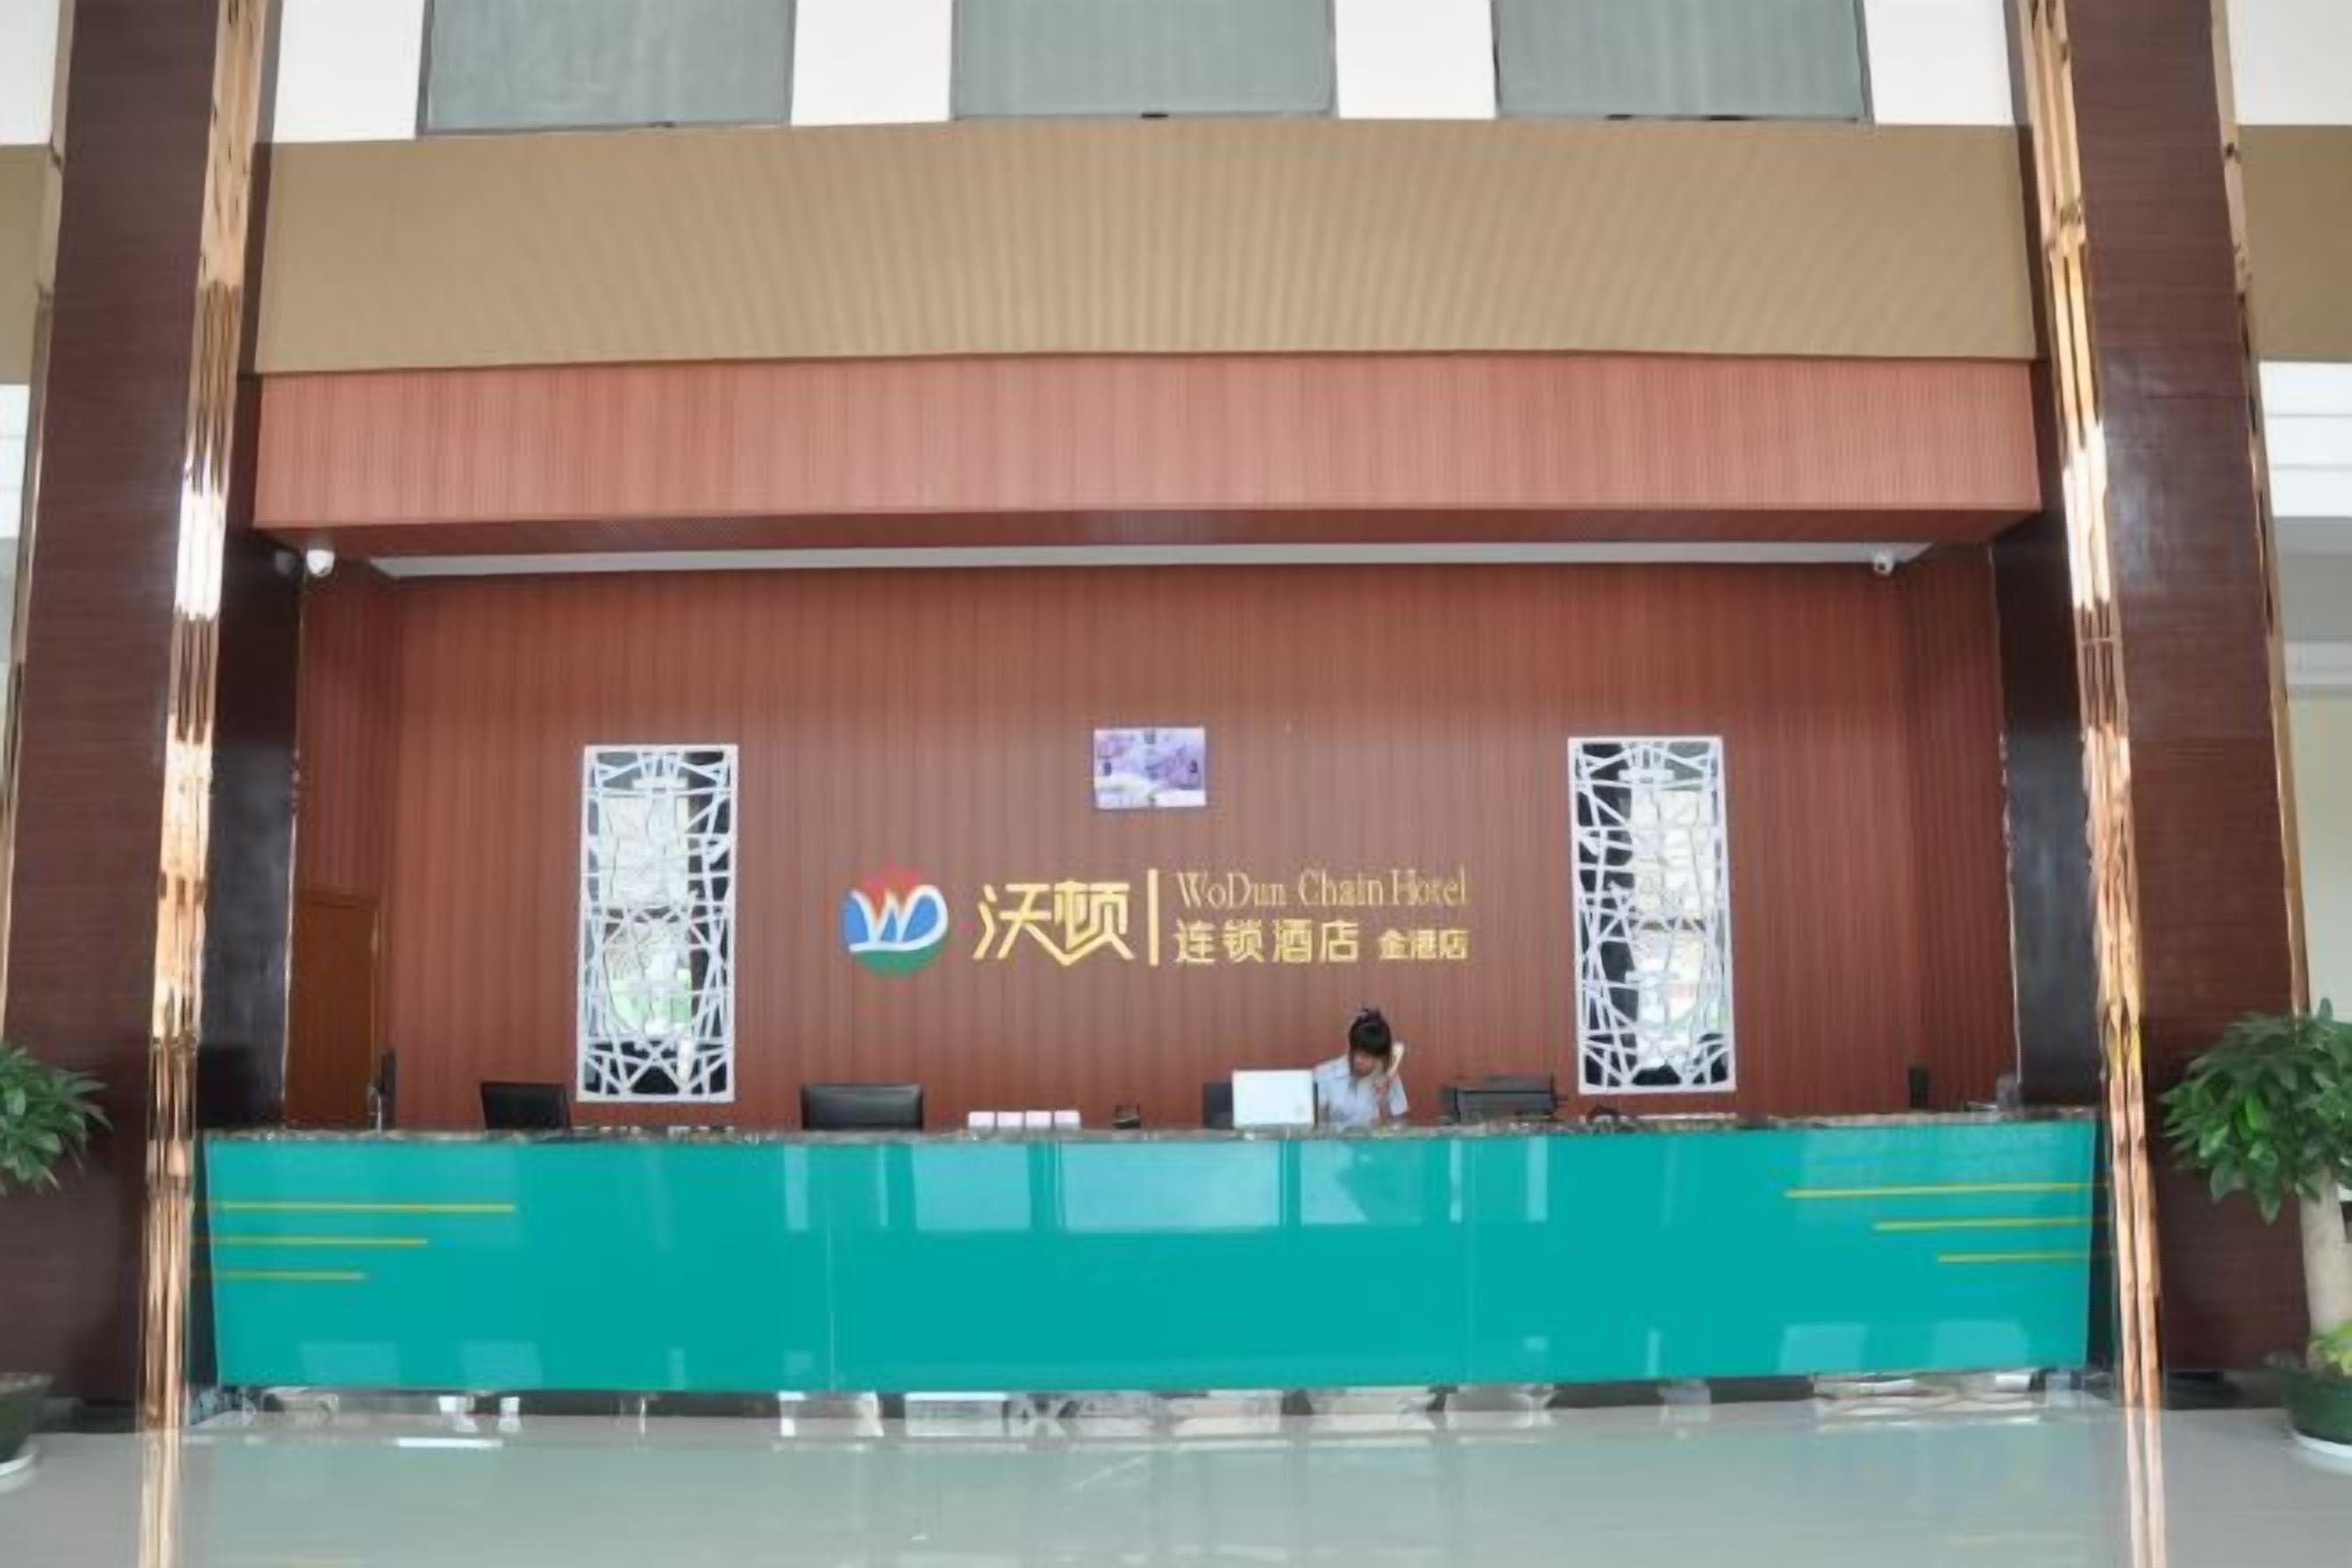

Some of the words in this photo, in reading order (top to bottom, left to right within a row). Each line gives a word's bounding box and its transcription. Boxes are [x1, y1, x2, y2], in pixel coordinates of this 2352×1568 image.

[1175, 870, 1287, 909] WoDun
[1297, 868, 1384, 908] Chain
[1390, 866, 1467, 907] Hotel
[973, 880, 1134, 967] 沃顿
[1173, 919, 1359, 964] 连锁酒店
